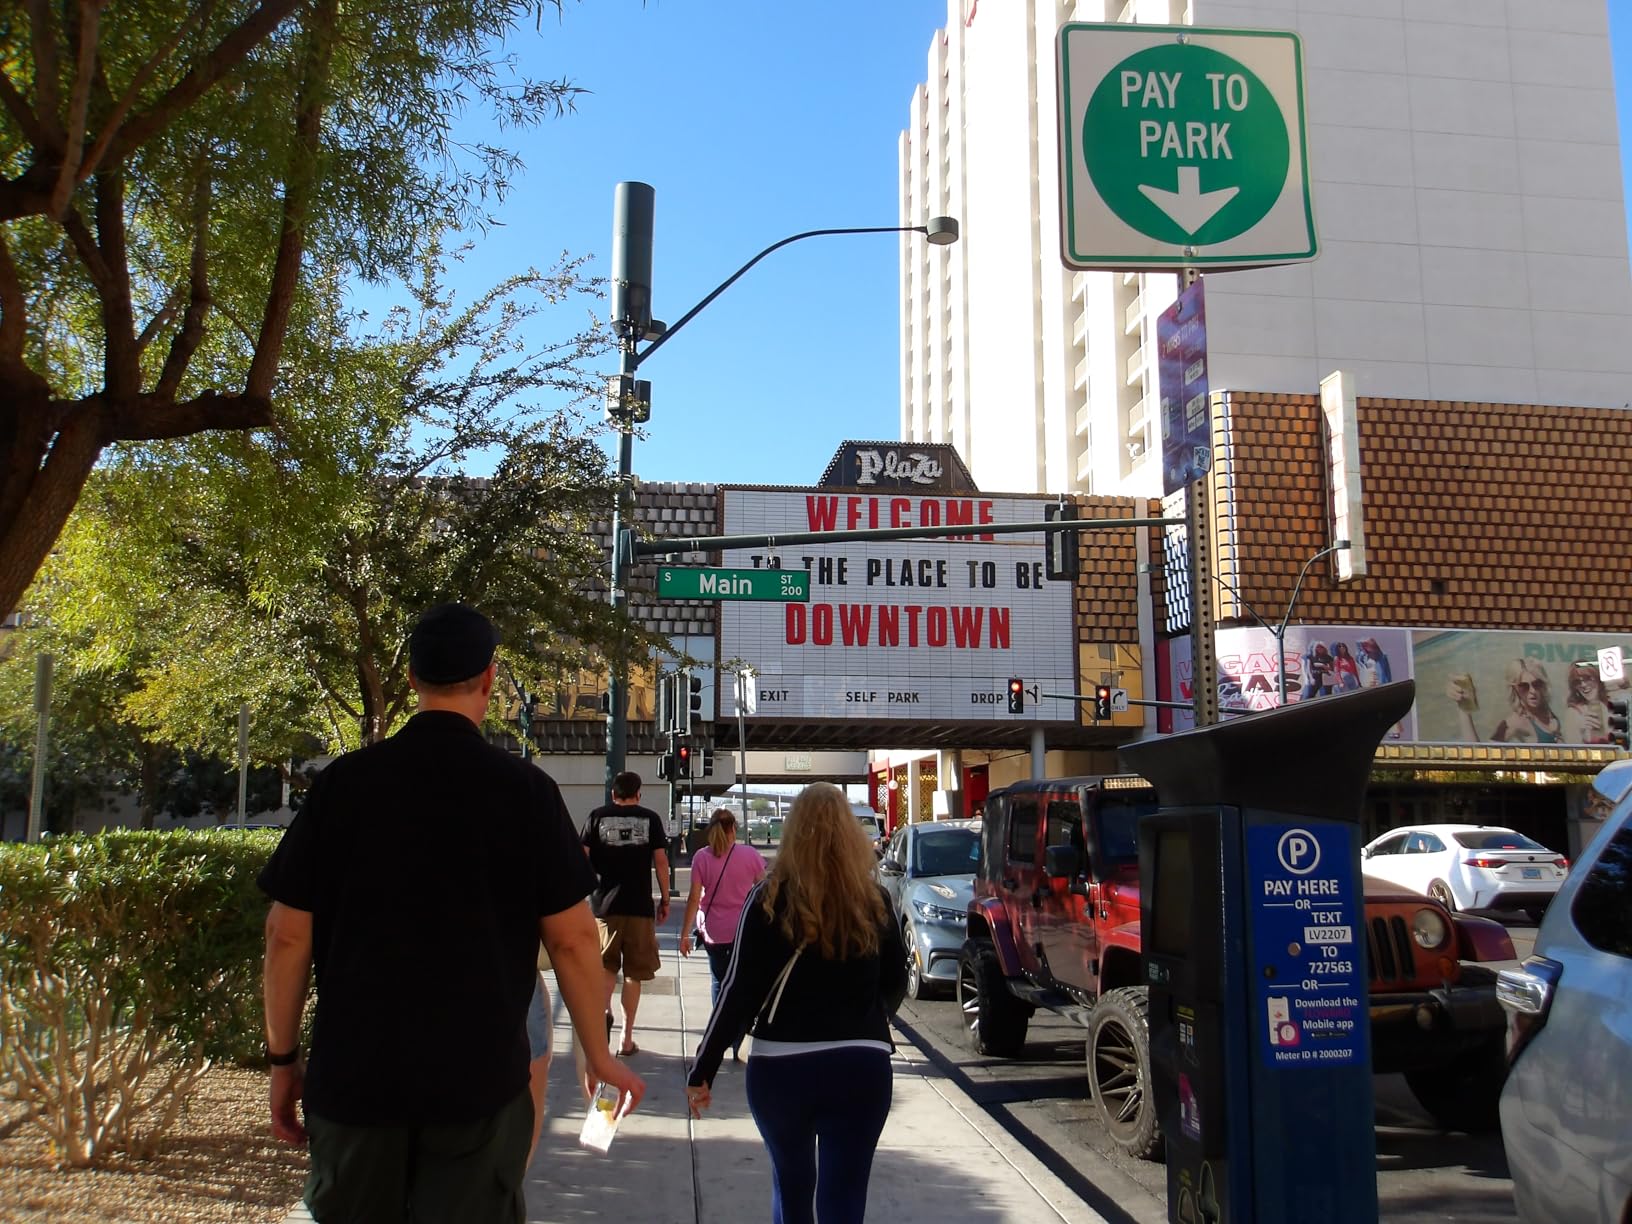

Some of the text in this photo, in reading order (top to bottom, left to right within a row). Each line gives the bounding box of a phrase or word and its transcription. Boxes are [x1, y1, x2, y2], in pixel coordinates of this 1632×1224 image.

[1120, 71, 1249, 112] PAY TO
[1140, 120, 1233, 160] PARK
[856, 447, 943, 486] Plaza
[805, 495, 994, 542] WELCOME
[801, 556, 848, 585] THE
[867, 558, 947, 587] PLACE
[966, 560, 996, 588] TO
[1015, 561, 1043, 589] BE
[664, 571, 792, 595] S Main ST
[780, 586, 803, 596] 200
[785, 602, 1010, 649] DOWNTOWN
[759, 690, 789, 701] EXIT
[845, 691, 920, 703] SELF PARK
[971, 693, 1004, 704] DROP
[1289, 838, 1308, 865] P
[1264, 879, 1339, 896] PAY HERE
[1294, 899, 1311, 910] OR
[1311, 911, 1342, 924] TEXT
[1309, 929, 1347, 940] LV2207
[1320, 945, 1338, 958] TO
[1308, 961, 1353, 974] 727563
[1301, 979, 1318, 990] OR
[1295, 996, 1358, 1008] Download the
[1302, 1019, 1354, 1030] Mobile app
[1275, 1051, 1300, 1061] Meter
[1301, 1050, 1311, 1059] ID
[1319, 1048, 1353, 1059] 2000207
